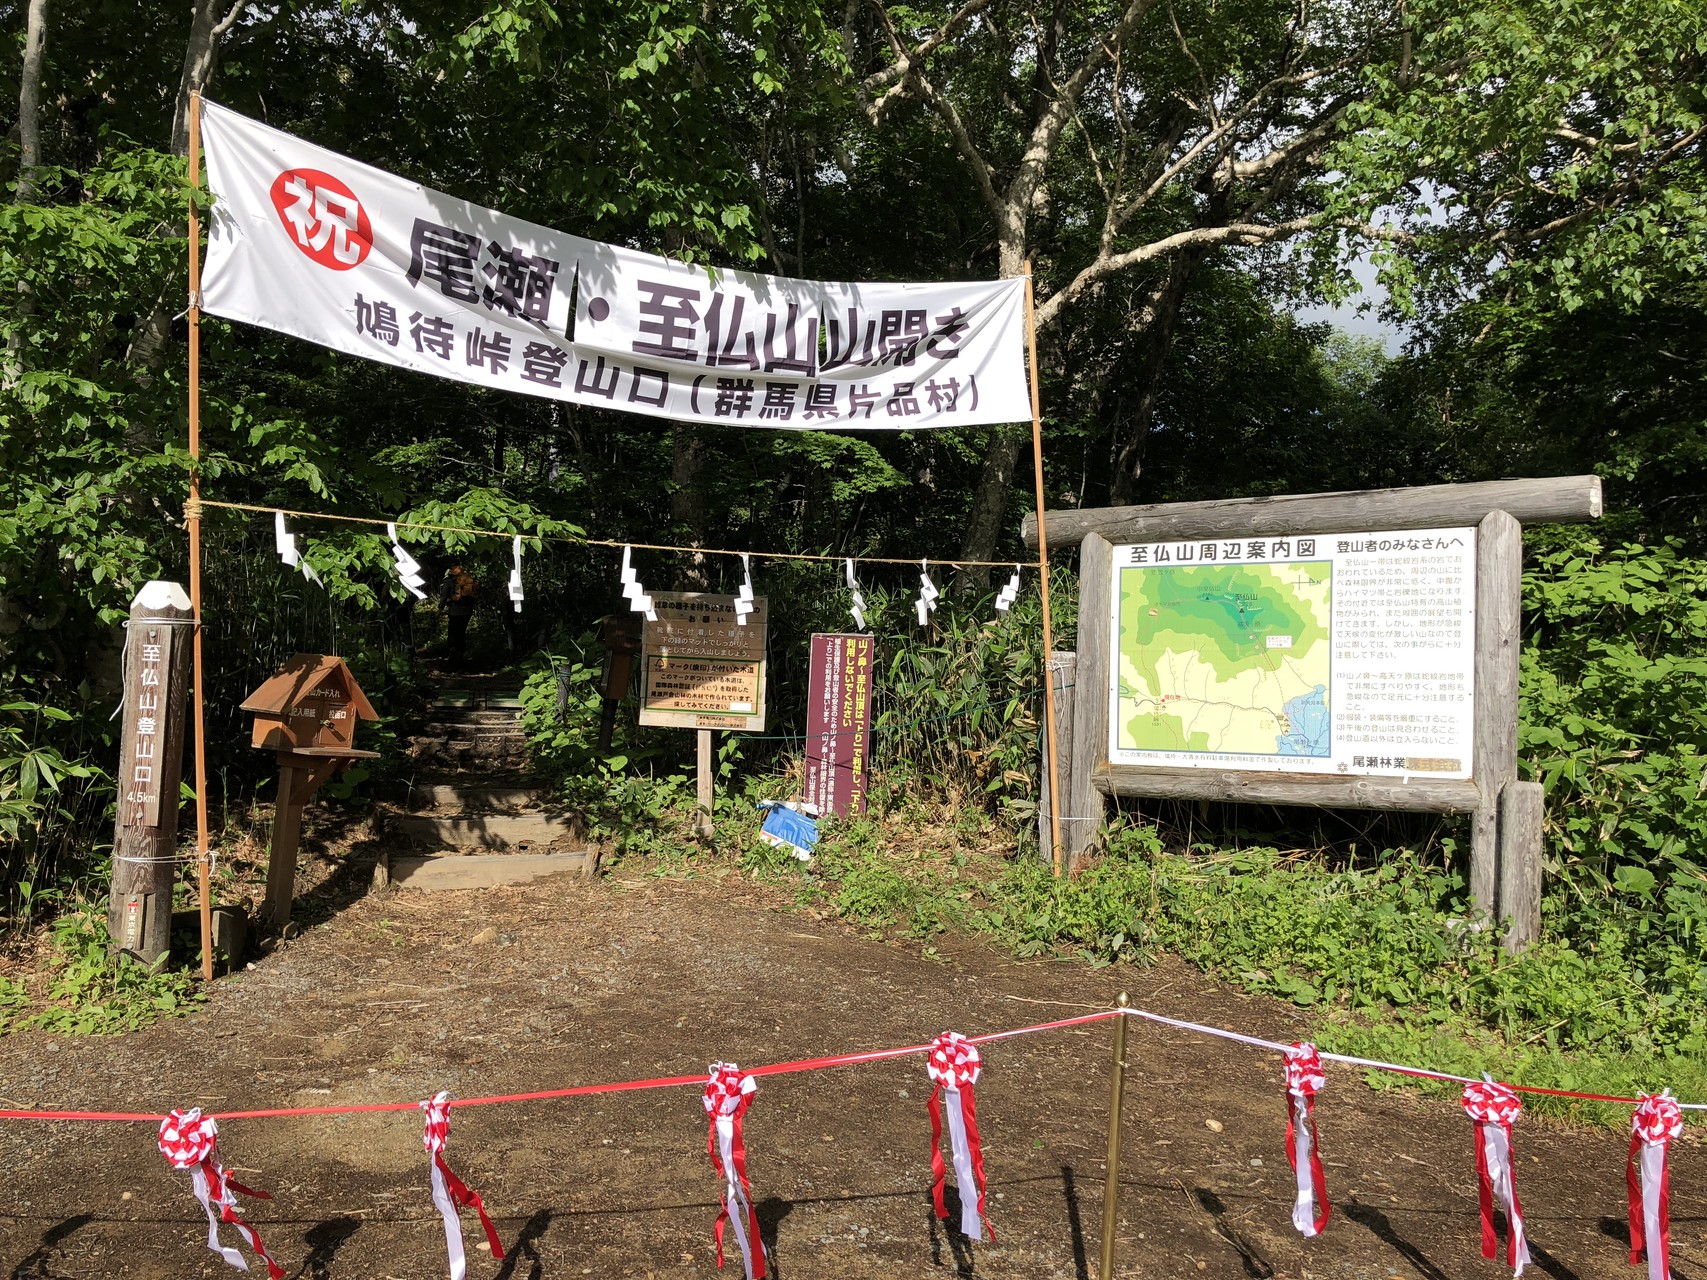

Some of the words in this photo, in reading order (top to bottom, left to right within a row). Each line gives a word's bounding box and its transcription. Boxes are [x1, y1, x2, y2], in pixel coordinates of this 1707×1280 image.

[283, 172, 361, 268] 祝
[404, 217, 973, 377] 尾瀬・至仏山山開き
[354, 291, 980, 420] 鳩待峠登山口（群馬県片品村）
[1130, 538, 1316, 564] 至仏山周辺案内図
[1336, 537, 1464, 554] 登山者のみなさんへ
[134, 643, 162, 784] 至仏山登山口
[842, 638, 857, 728] 利用しないでください
[126, 791, 157, 804] 4.5km
[1352, 755, 1407, 769] 尾瀬林業
